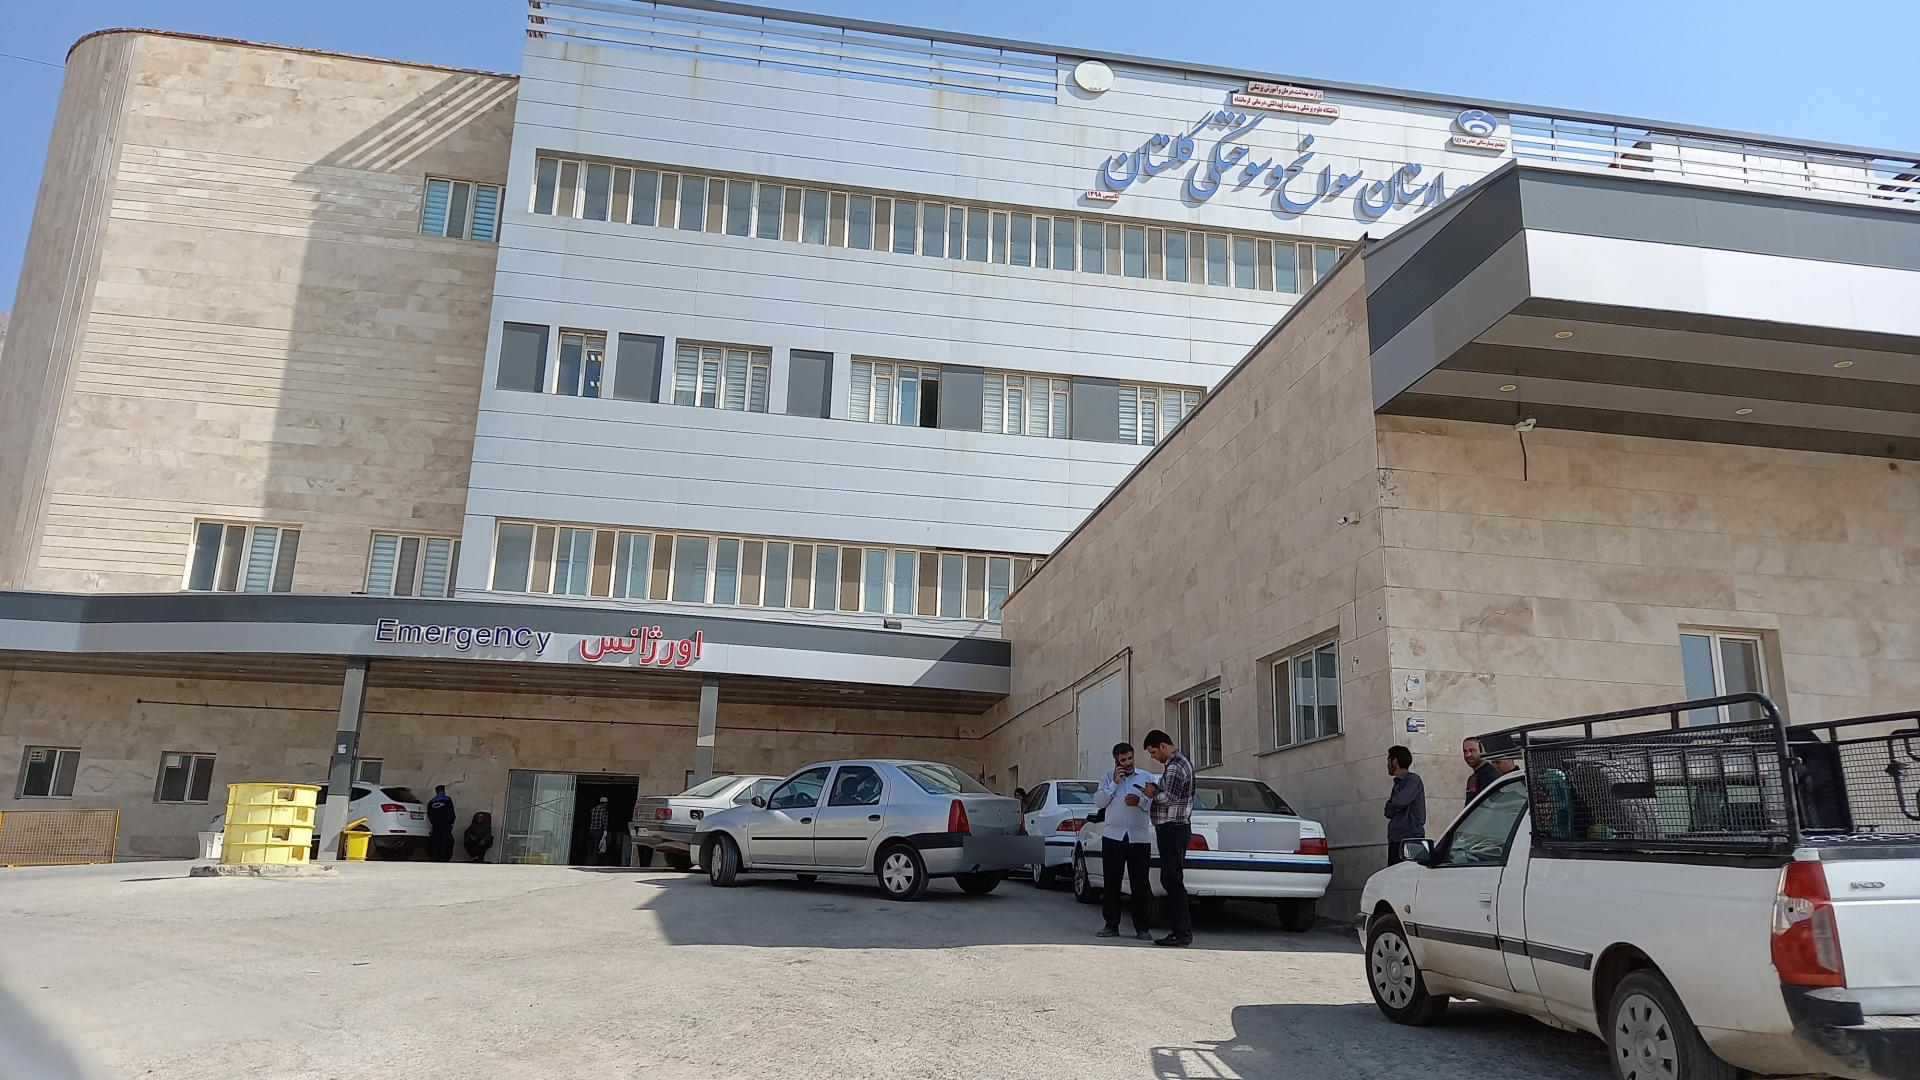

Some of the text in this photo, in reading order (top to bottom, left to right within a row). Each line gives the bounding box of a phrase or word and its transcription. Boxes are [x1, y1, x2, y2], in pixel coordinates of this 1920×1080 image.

[1104, 110, 1215, 191] گلستان
[374, 617, 551, 654] Emergency
[580, 624, 704, 667] اورژانس
